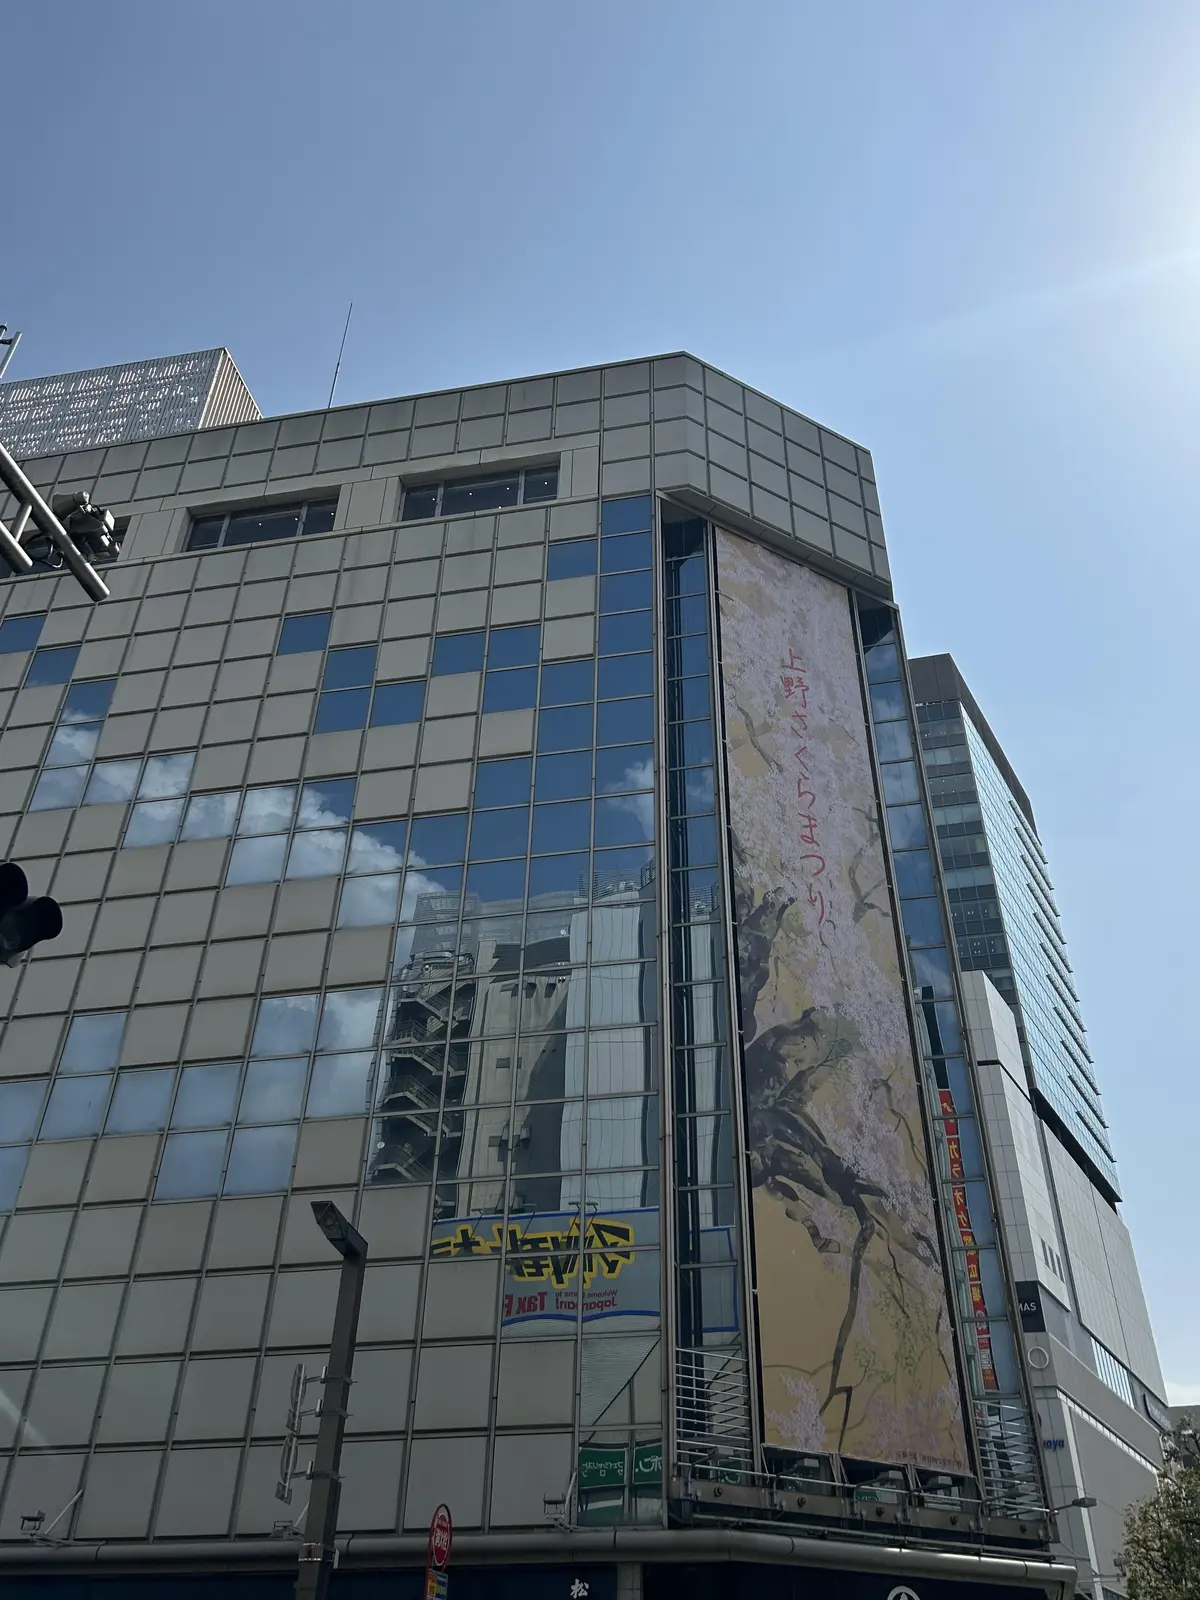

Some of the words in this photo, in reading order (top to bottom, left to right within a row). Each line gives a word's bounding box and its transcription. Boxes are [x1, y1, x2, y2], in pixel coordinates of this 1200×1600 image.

[779, 648, 826, 925] 上野さくらまつり
[570, 1578, 590, 1599] 松
